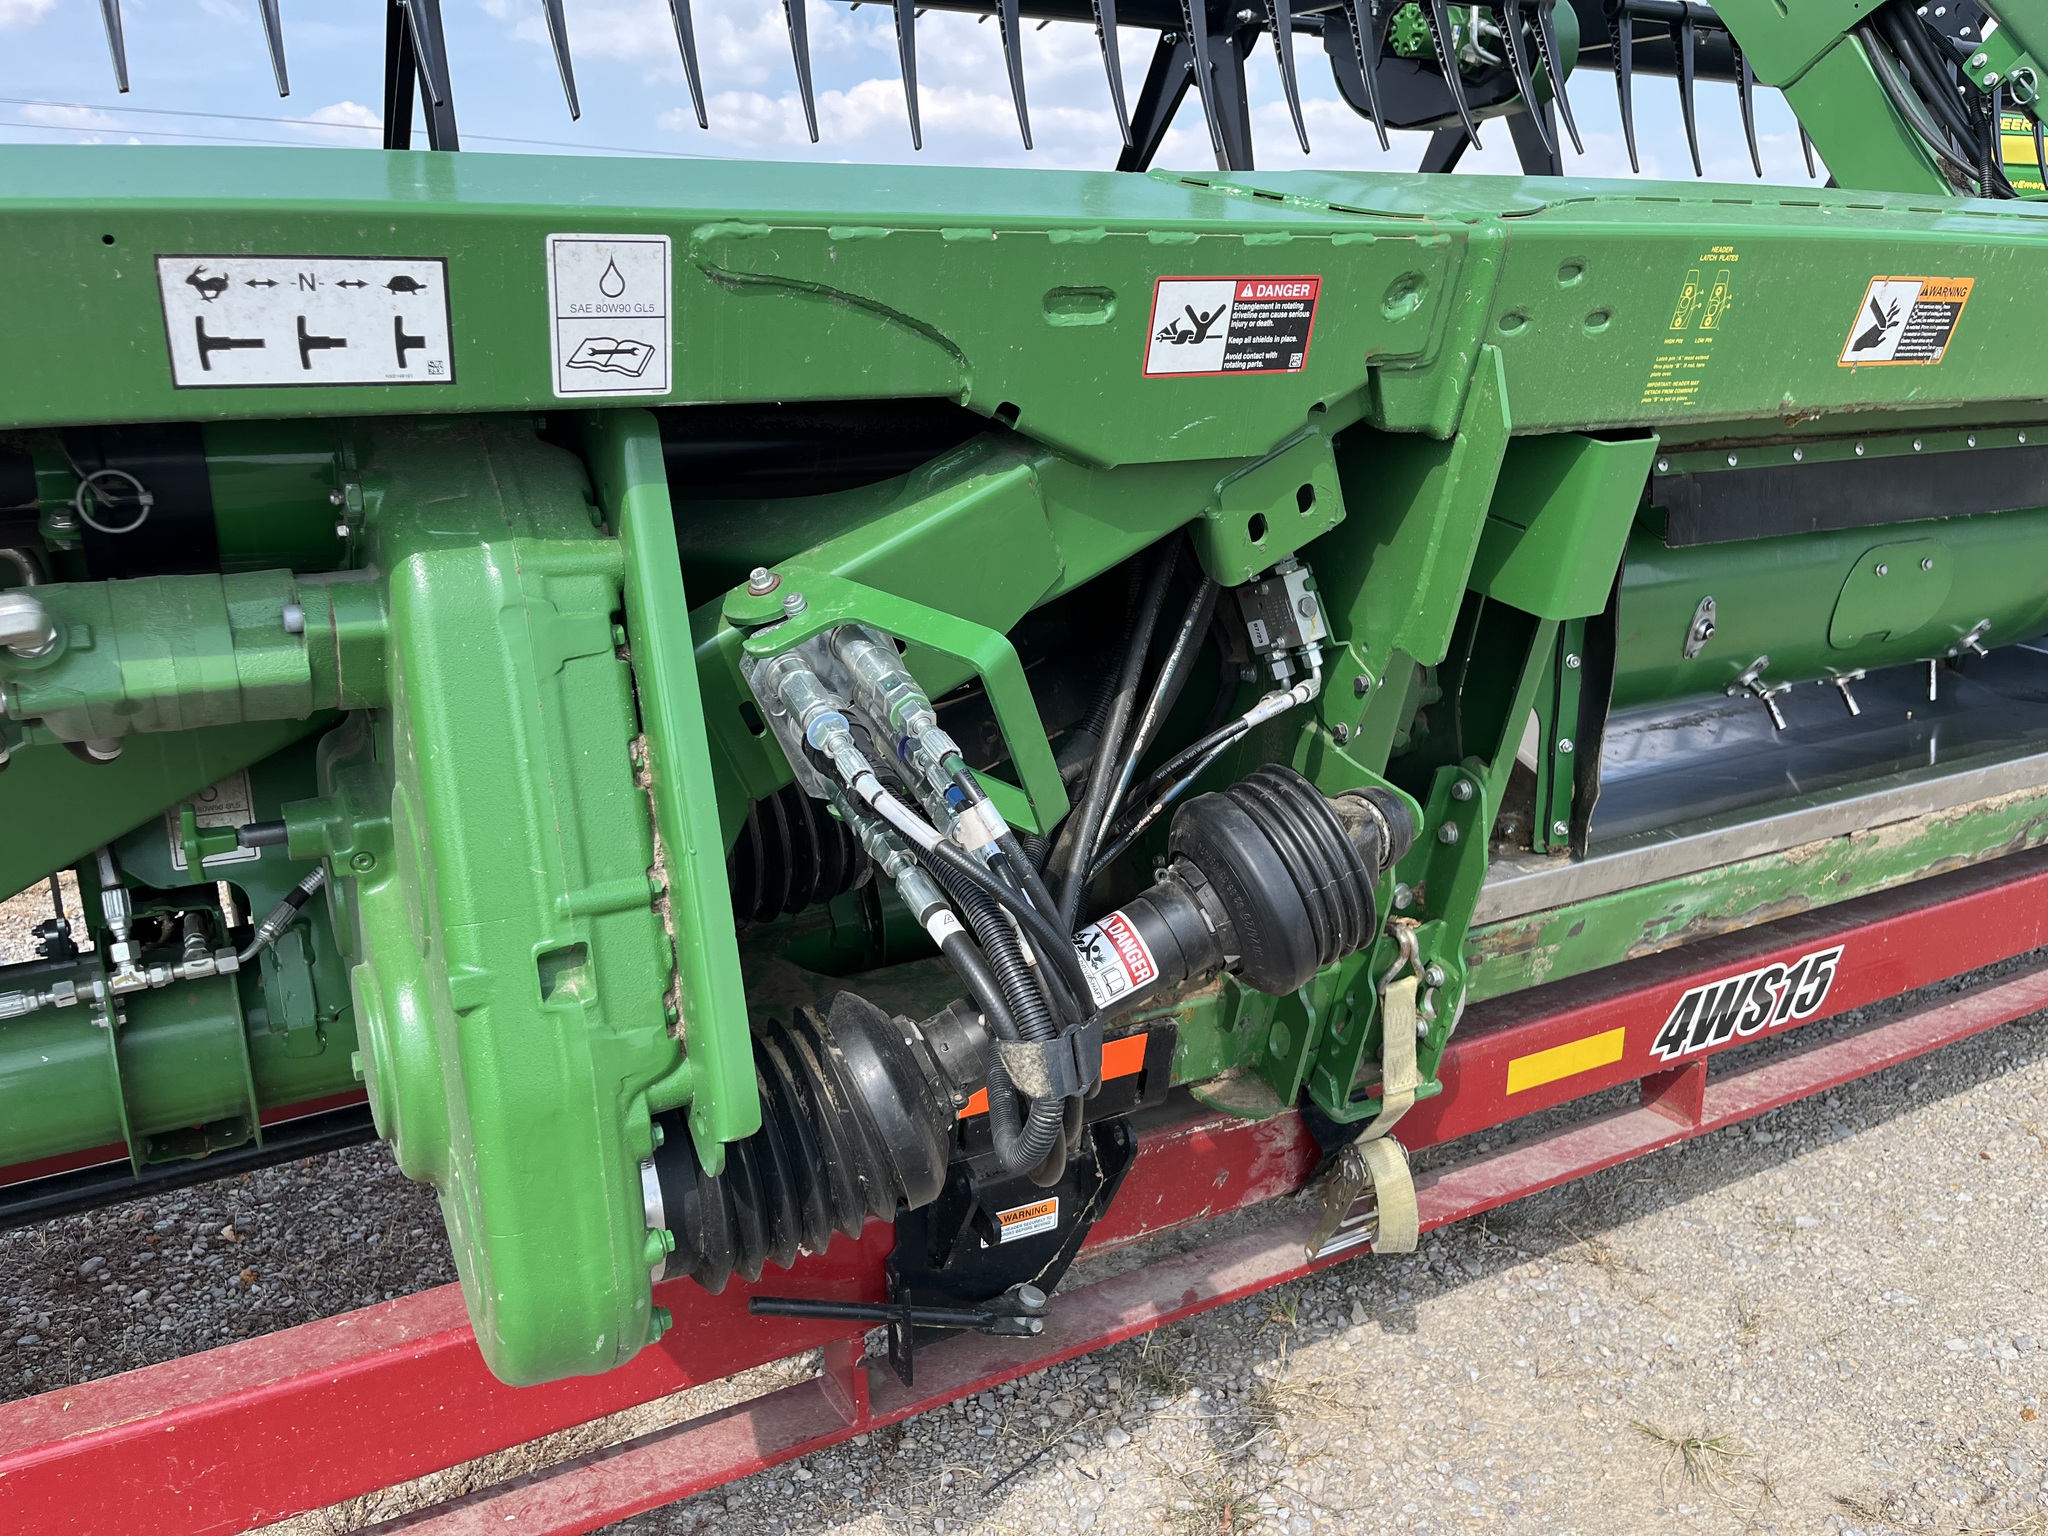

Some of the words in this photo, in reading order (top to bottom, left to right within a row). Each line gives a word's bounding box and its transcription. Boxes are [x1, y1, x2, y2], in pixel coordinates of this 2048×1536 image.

[2000, 118, 2033, 131] EER
[1256, 284, 1310, 296] DANGER
[1929, 286, 1967, 297] WARNING
[570, 304, 592, 313] SAE
[596, 304, 631, 313] 80W90
[634, 303, 655, 312] GL5
[1234, 302, 1274, 311] Entanglement
[1282, 302, 1304, 310] rotating
[1228, 336, 1243, 345] Keep
[1280, 335, 1298, 344] place.
[1247, 361, 1263, 369] parts.
[1192, 598, 1200, 612] 22.5
[1157, 770, 1168, 780] USA
[1108, 922, 1151, 983] DANGER
[1650, 945, 1845, 1062] 4WS15
[1003, 1205, 1047, 1223] WARNING
[1005, 1224, 1022, 1232] HEADER
[1024, 1218, 1046, 1228] SECURELY
